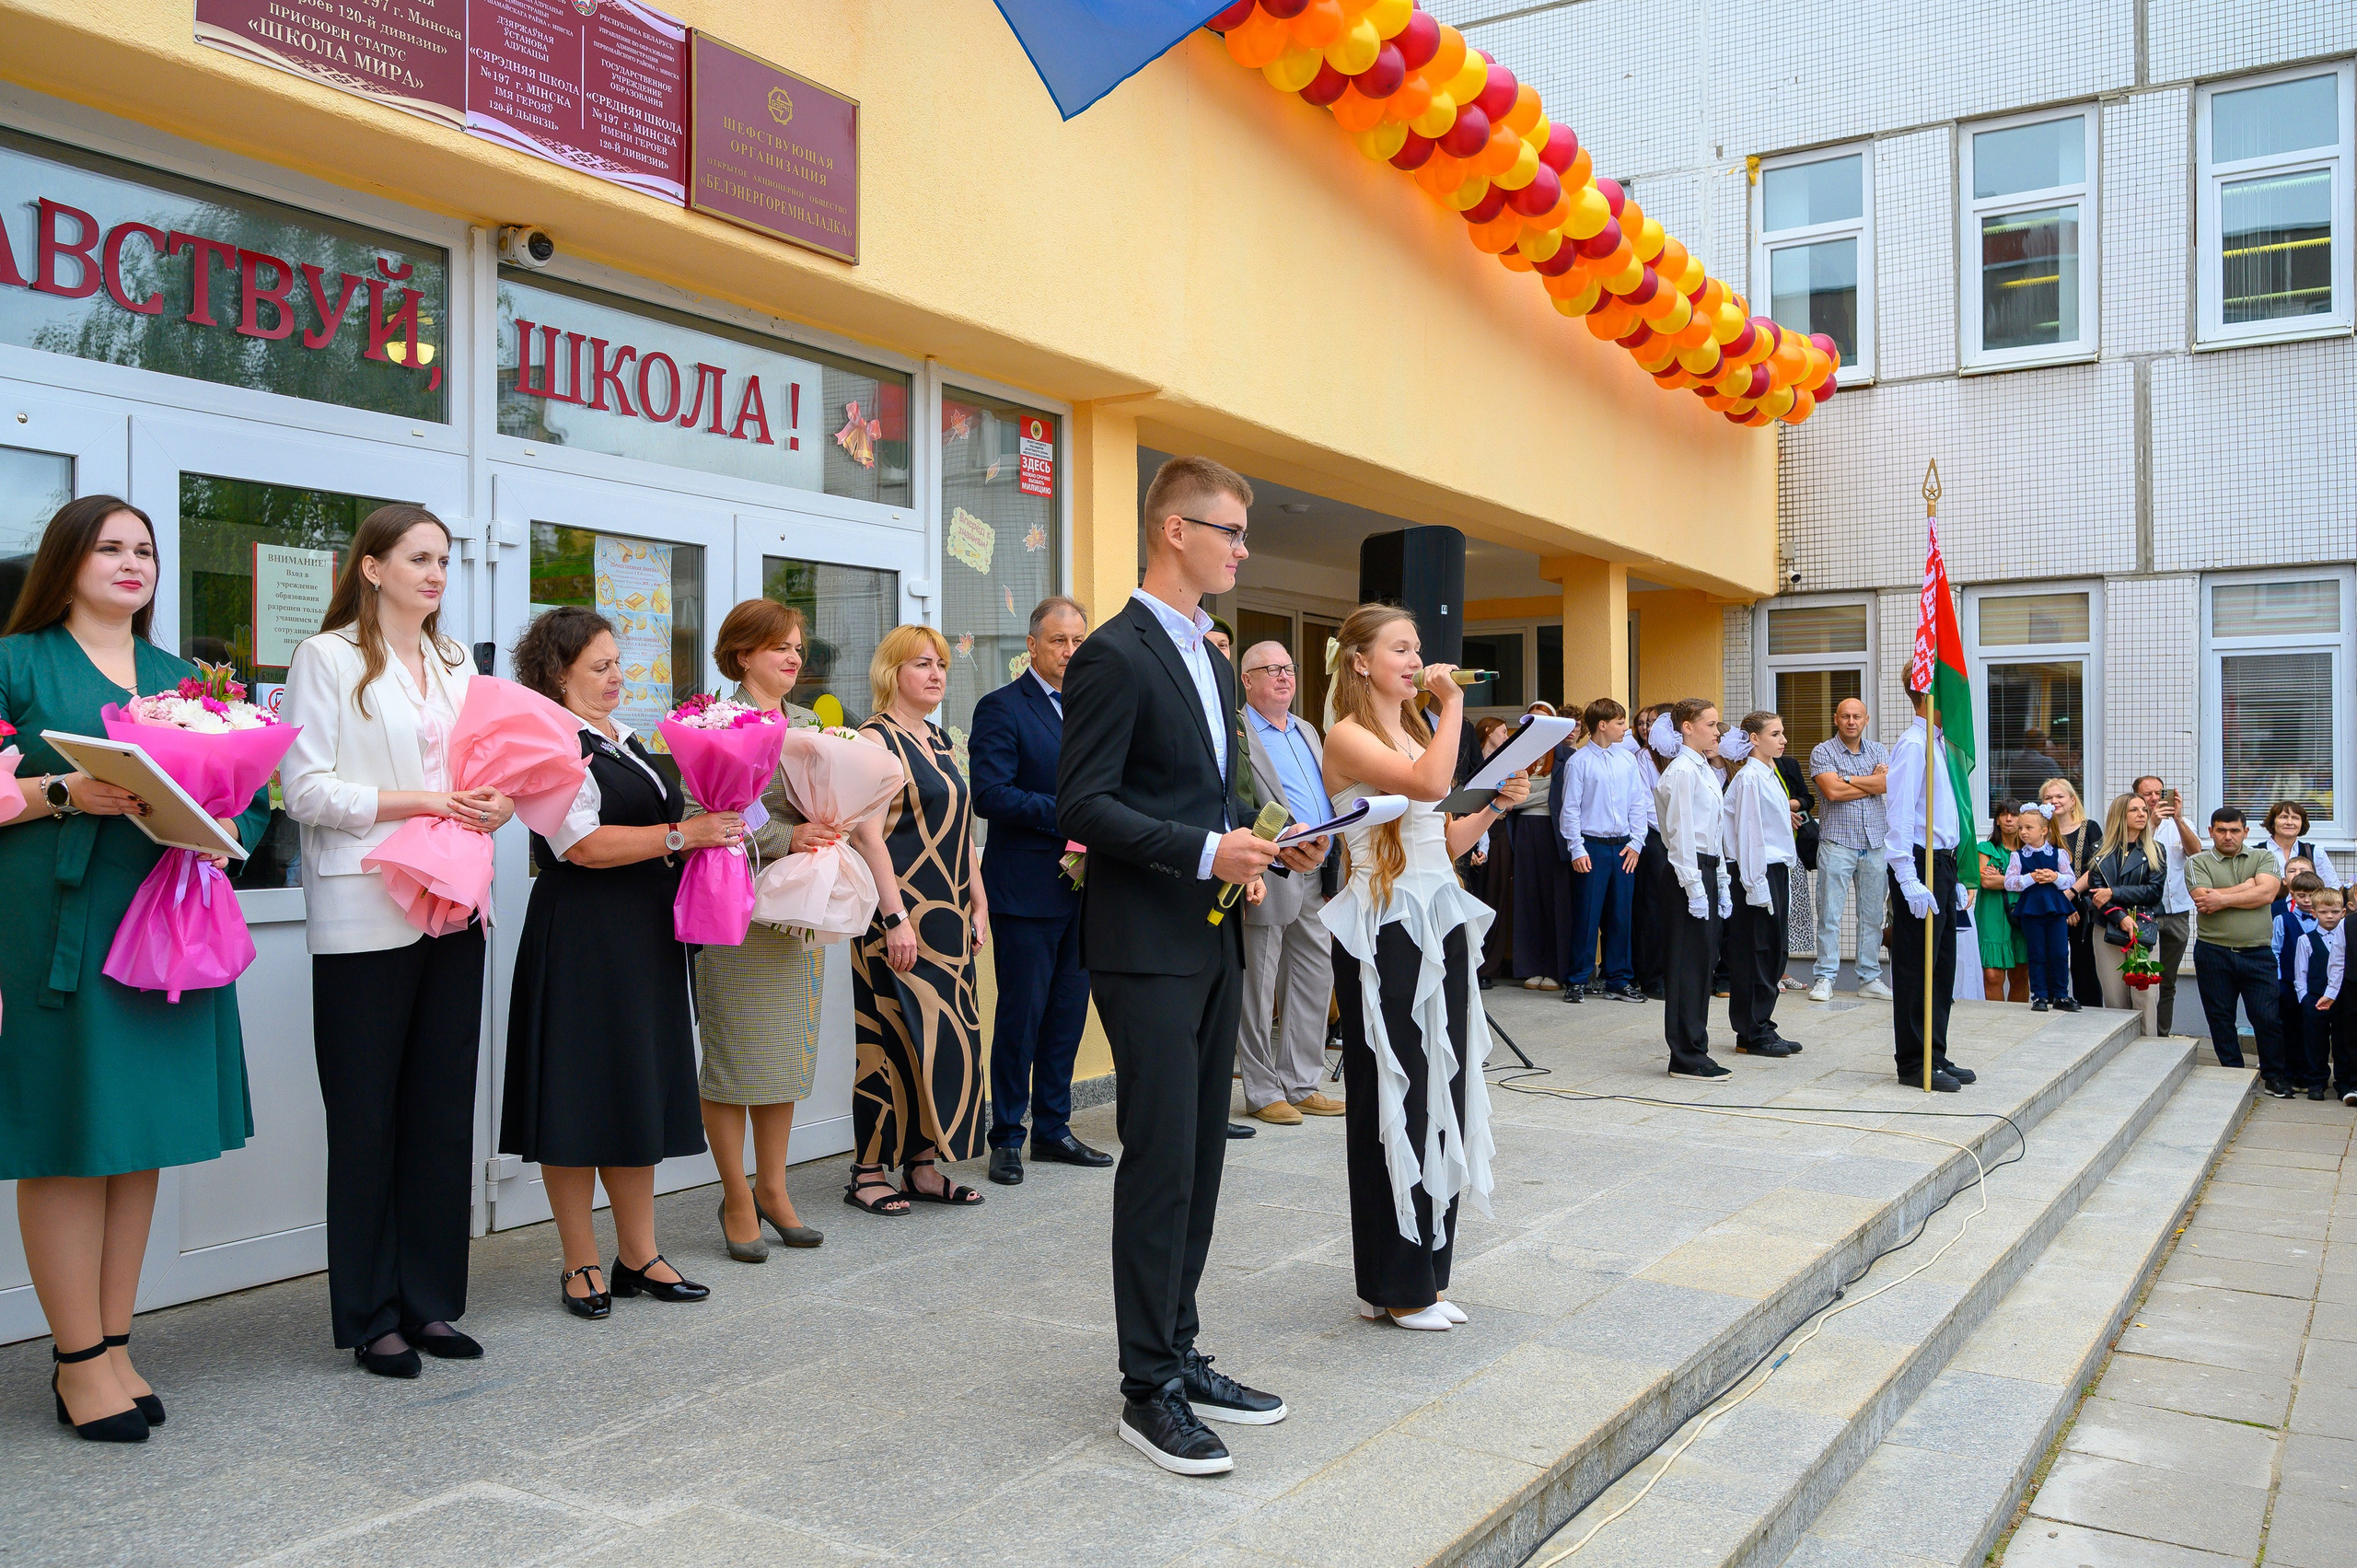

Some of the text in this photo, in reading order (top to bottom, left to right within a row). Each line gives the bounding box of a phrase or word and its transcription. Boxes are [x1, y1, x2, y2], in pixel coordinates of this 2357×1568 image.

[269, 2, 407, 62] ПРИСВОЕН СТАТУС
[339, 5, 376, 29] 120-й
[380, 23, 447, 55] дивизии»
[393, 6, 403, 17] г.
[407, 7, 462, 41] Минска
[497, 15, 554, 44] ДЗЯРЖАЎНАЯ
[599, 13, 675, 51] РЕСПУБЛИКА БЕЛАРУСЬ
[248, 17, 424, 89] «ШКОЛА МИРА»
[470, 46, 581, 97] «СЯРЭДНЯЯ ШКОЛА
[601, 58, 672, 93] ГОСУДАРСТВЕННОЕ
[611, 72, 663, 99] УЧРЕЖДЕНИЕ
[489, 99, 514, 116] 120-Й
[494, 85, 554, 114] ІМЯ ГЕРОЯЎ
[526, 82, 572, 109] МІНСКА
[610, 81, 663, 109] ОБРАЗОВАНИЯ
[586, 91, 683, 135] «СРЕДНЯЯ ШКОЛА
[599, 123, 668, 157] ИМЕНИ ГЕРОЕВ
[633, 122, 678, 148] МИНСКА
[723, 116, 834, 170] ШЕФСТВУЮЩАЯ
[598, 139, 669, 171] 120-Й ДИВИЗИИ»
[729, 139, 828, 187] ОРГАНИЗАЦИЯ
[706, 157, 848, 215] ОТКРЫТОЕ АКЦИОНЕРНОЕ ОБЩЕСТВО
[700, 173, 853, 238] «БЕЛЭНЕРГОРЕМНАЛАДКА»
[1022, 456, 1051, 474] ЗДЕСЬ
[1021, 482, 1051, 495] МИЛИЦИЮ
[958, 511, 985, 538] Вперёд
[958, 526, 989, 551] знаниям!
[267, 553, 328, 568] ВНИМАНИЕ!
[285, 569, 303, 578] Вход
[274, 590, 319, 602] образования
[276, 581, 319, 591] учреждение
[267, 603, 301, 612] разрешен
[275, 614, 312, 623] учащимся
